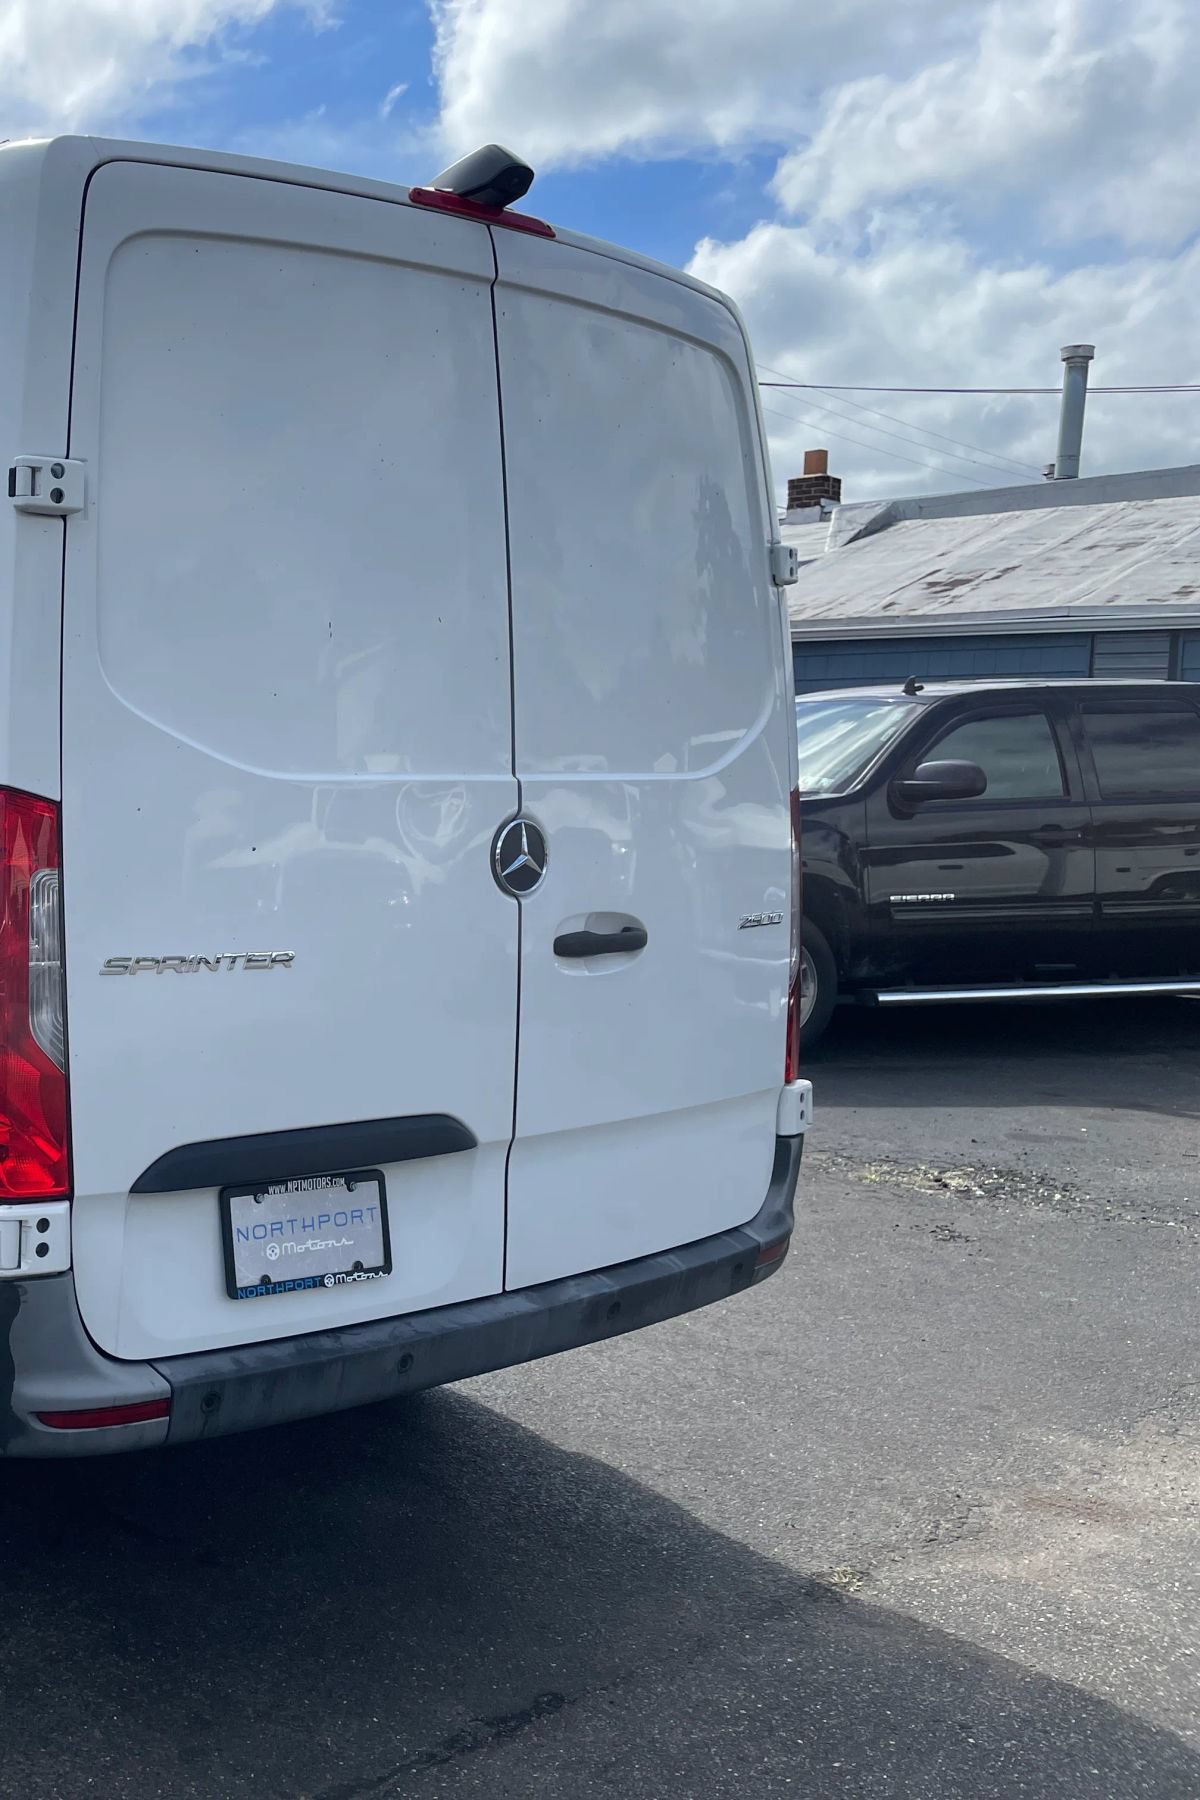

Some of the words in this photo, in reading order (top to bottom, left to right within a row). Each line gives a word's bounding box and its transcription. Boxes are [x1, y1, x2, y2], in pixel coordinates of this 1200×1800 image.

[99, 950, 297, 976] SPRINTER
[268, 1177, 345, 1195] WWW.NPTMOTORS.COM
[236, 1207, 378, 1243] NORTHPORT
[282, 1238, 354, 1256] Motors
[237, 1277, 322, 1299] NORTHPORT
[336, 1272, 388, 1284] Motors
